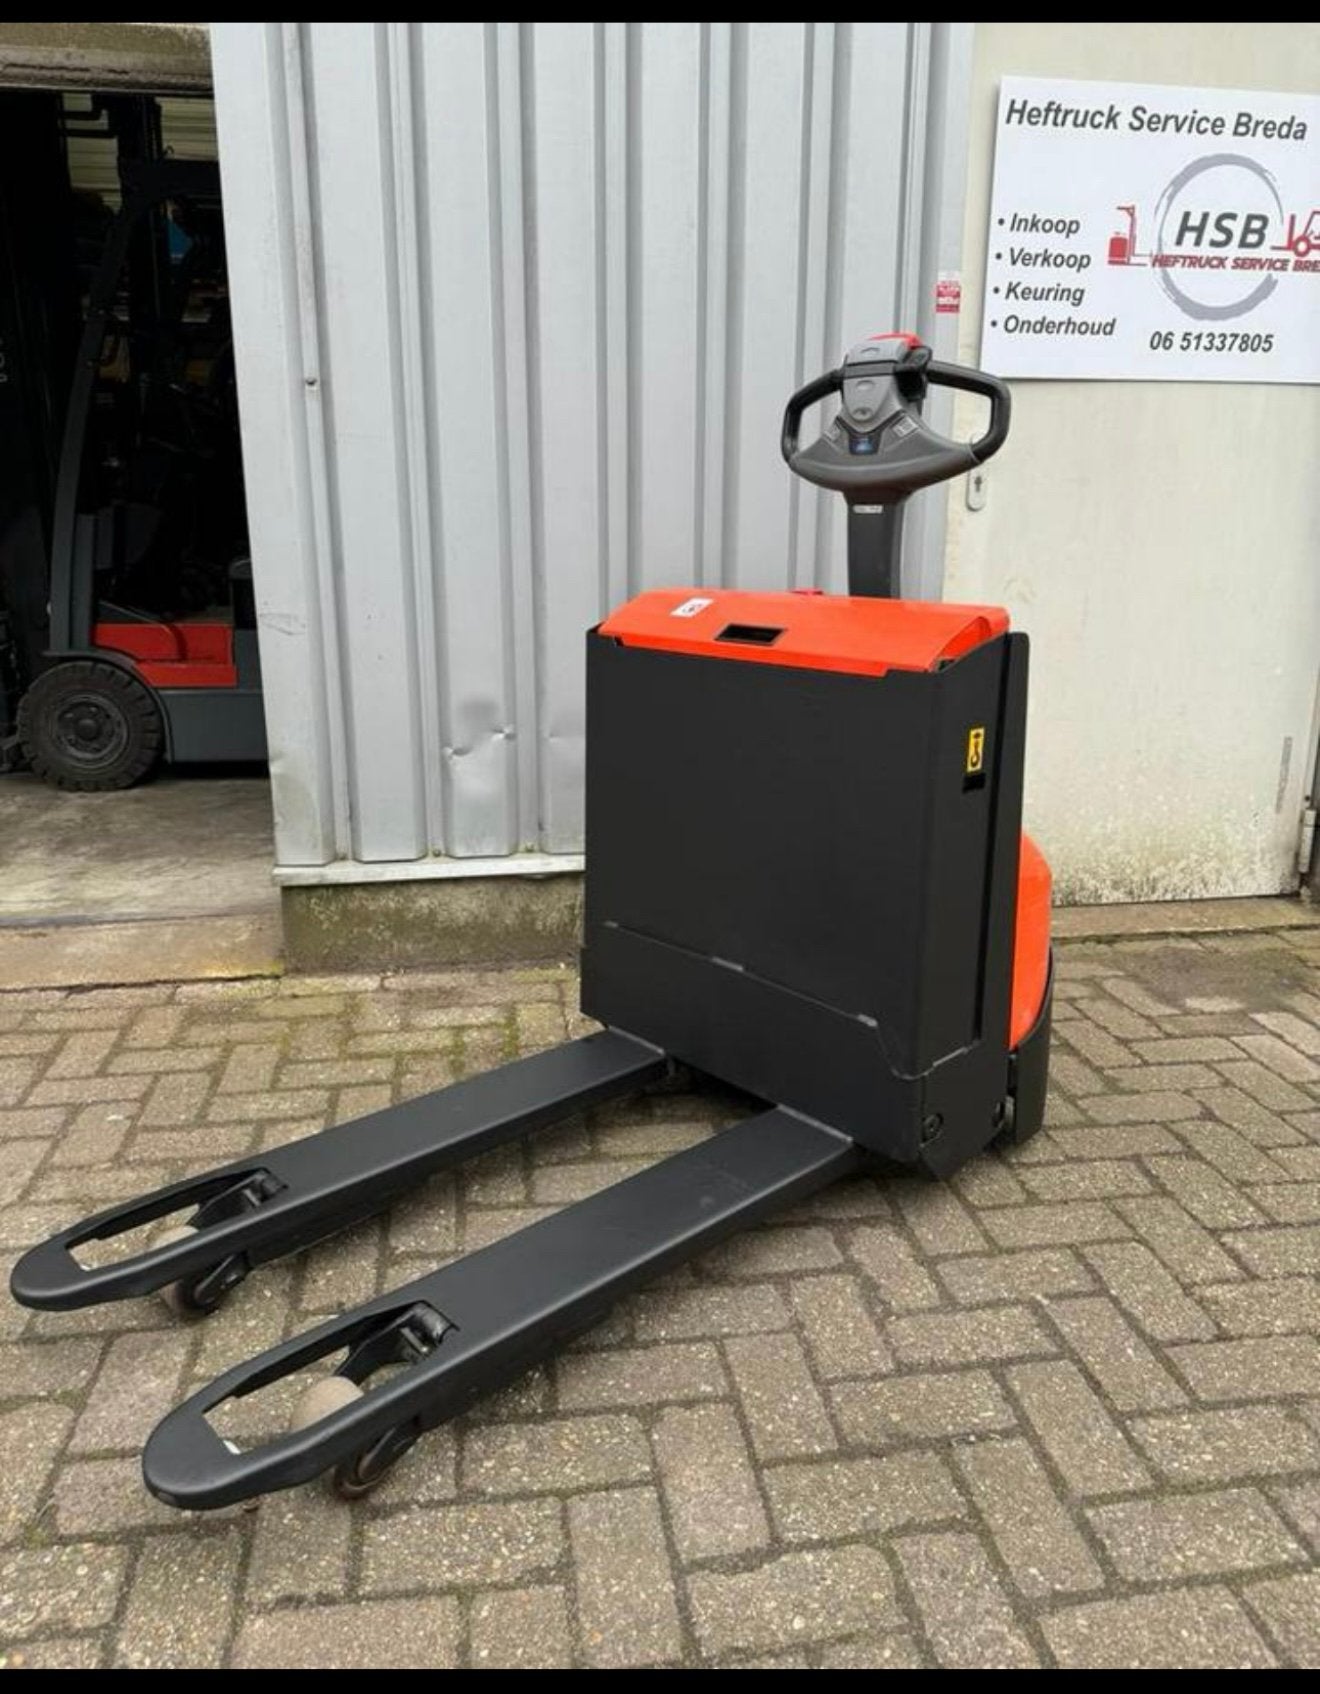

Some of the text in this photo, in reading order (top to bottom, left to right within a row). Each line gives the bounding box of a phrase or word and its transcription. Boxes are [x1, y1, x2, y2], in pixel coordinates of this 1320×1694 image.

[1006, 99, 1307, 140] Heftruck Service Breda
[1010, 213, 1080, 235] Inkoop
[1175, 211, 1269, 249] HSB
[1010, 248, 1091, 272] Verkoop
[1151, 254, 1228, 268] HEFTRUCK
[1231, 257, 1290, 271] SERVICE
[1005, 282, 1085, 306] Keuring
[1004, 315, 1116, 335] Onderhoud
[1150, 331, 1273, 352] 06 51337805
